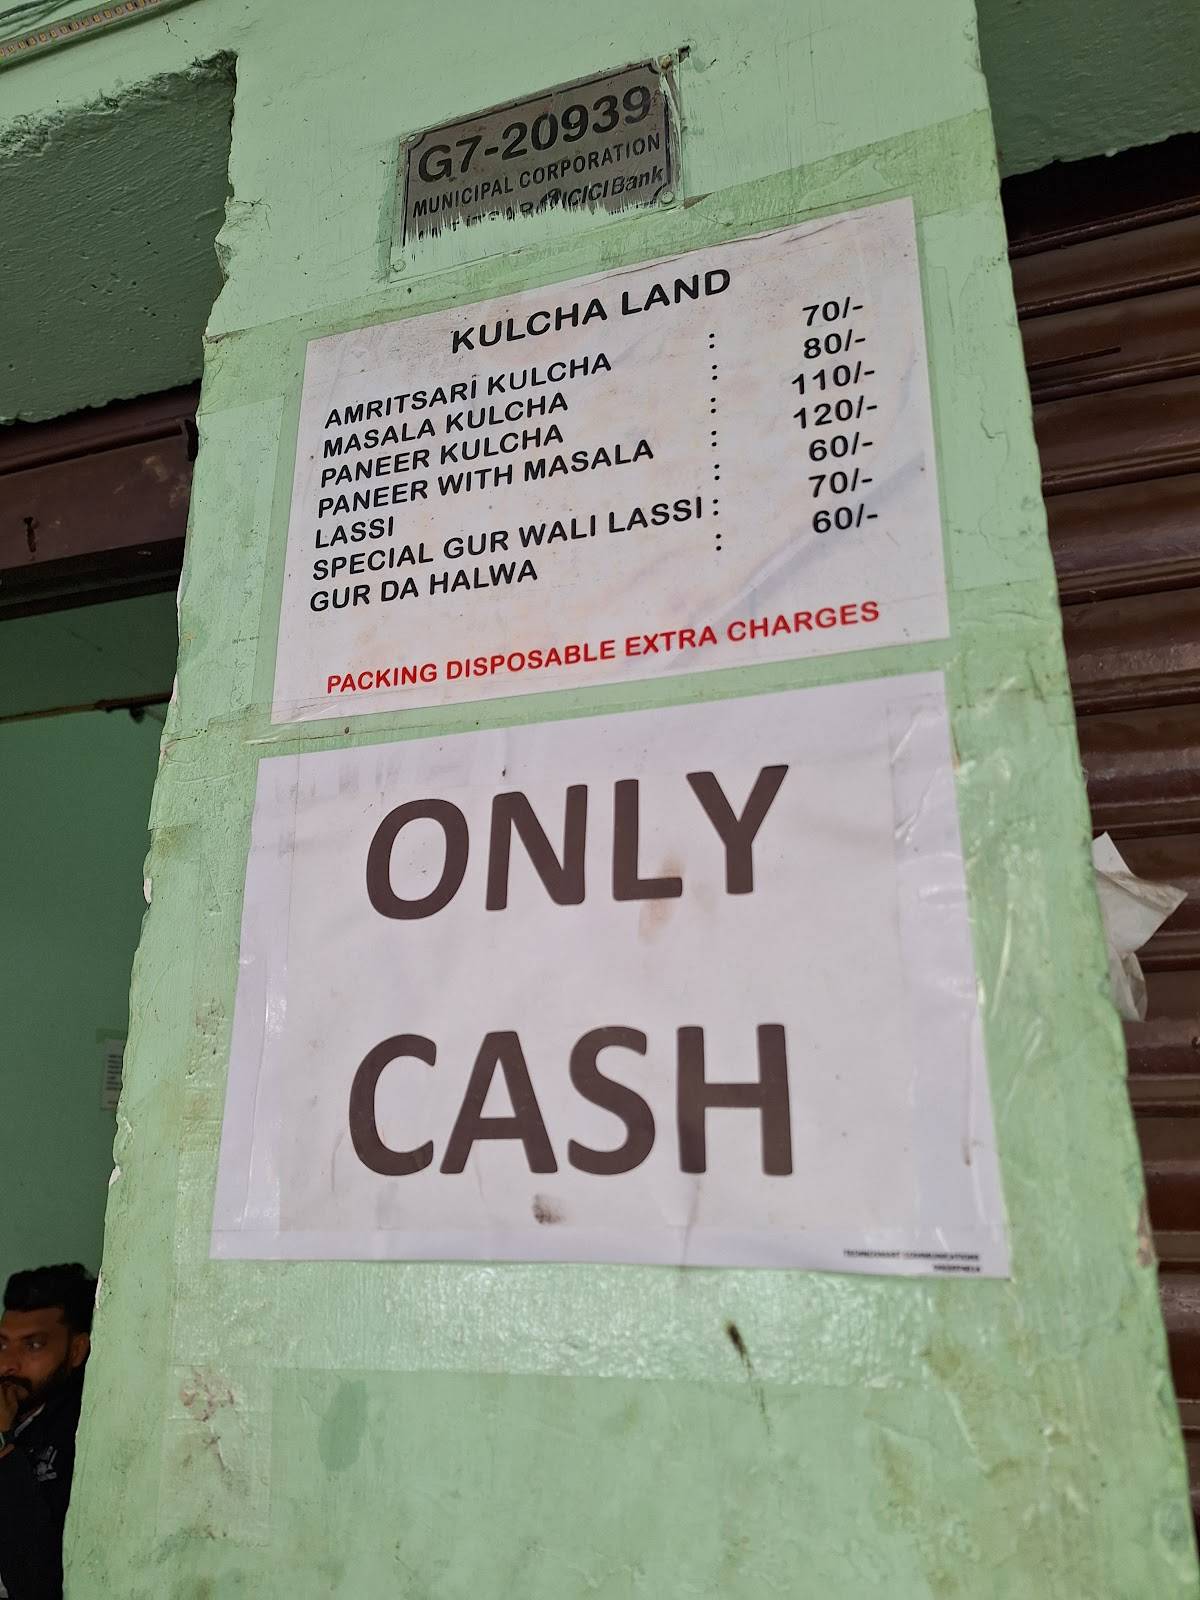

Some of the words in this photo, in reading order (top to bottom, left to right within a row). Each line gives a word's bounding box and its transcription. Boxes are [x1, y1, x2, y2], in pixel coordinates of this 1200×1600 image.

[412, 176, 514, 218] MUNICIPAL
[519, 132, 661, 189] CORPORATION
[418, 85, 652, 183] G7-20939
[611, 165, 664, 197] Bank
[324, 378, 477, 430] AMRITSARI
[487, 352, 612, 397] KULCHA
[801, 296, 865, 327] 70/-
[452, 297, 608, 355] KULCHA
[621, 268, 731, 316] LAND
[320, 447, 430, 489] PANEER
[440, 423, 564, 466] KULCHA
[791, 360, 876, 395] 110/-
[323, 418, 436, 459] MASALA
[445, 391, 569, 434] KULCHA
[803, 328, 867, 360] 80/-
[314, 515, 395, 550] LASSI
[808, 431, 874, 463] 60/-
[317, 478, 429, 519] PANEER
[437, 464, 514, 497] WITH
[523, 438, 655, 483] MASALA
[792, 394, 879, 430] 120/-
[309, 583, 371, 613] GUR
[380, 575, 420, 603] DA
[429, 559, 538, 596] HALWA
[811, 502, 879, 534] 60/-
[312, 541, 435, 581] SPECIAL
[443, 530, 509, 560] GUR
[518, 514, 597, 548] WALI
[608, 496, 702, 534] LASSI
[807, 467, 873, 499] 70/-
[326, 662, 438, 695] PACKING
[445, 639, 616, 682] DISPOSABLE
[624, 625, 719, 657] EXTRA
[725, 600, 881, 643] CHARGES
[365, 764, 790, 921] ONLY
[348, 1023, 793, 1177] CASH
